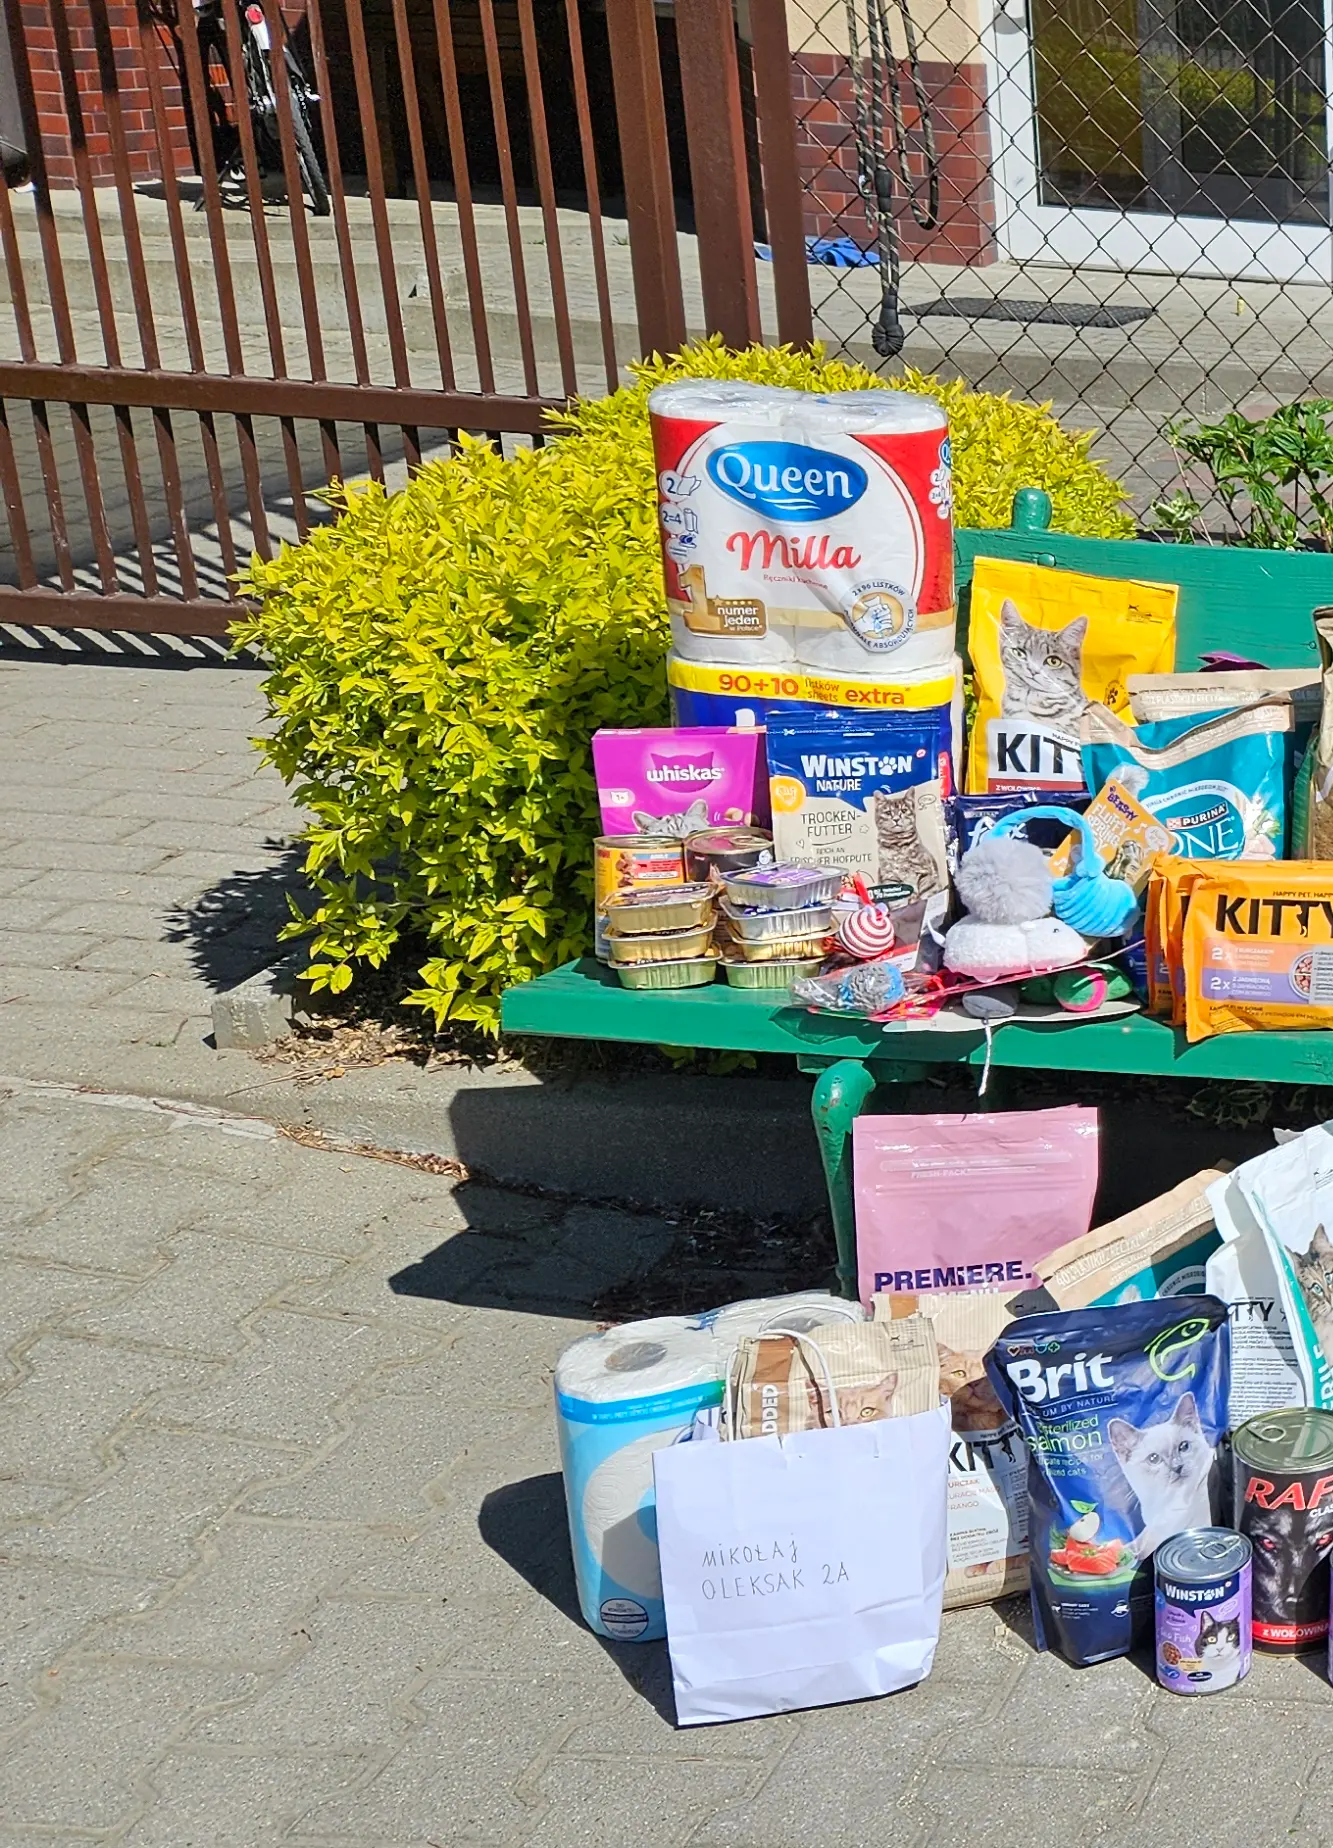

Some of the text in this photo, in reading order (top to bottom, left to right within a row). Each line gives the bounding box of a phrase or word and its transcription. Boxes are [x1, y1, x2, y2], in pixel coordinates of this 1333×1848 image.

[716, 452, 853, 499] Queen
[726, 530, 861, 571] Milla
[872, 582, 905, 596] LISTKÓW
[717, 606, 758, 616] numer
[724, 615, 760, 627] jeden
[719, 674, 799, 696] 90+10
[845, 688, 905, 705] extra
[808, 690, 838, 703] sheets
[646, 765, 723, 782] whiskas
[816, 778, 861, 792] NATURE
[801, 810, 861, 825] TROCKEN-
[1107, 793, 1138, 821] BEASTY
[1183, 805, 1227, 826] PURINA
[807, 824, 852, 837] FUTTER
[1087, 815, 1121, 846] SPRING
[1092, 803, 1132, 837] FLUFFY
[1168, 816, 1239, 858] ONE
[832, 853, 872, 864] HOFPUTE
[874, 1260, 1032, 1292] PREMIERE.
[1005, 1352, 1115, 1403] Brit
[1061, 1402, 1072, 1413] BY
[702, 1562, 850, 1600] OLEKSAK 2A
